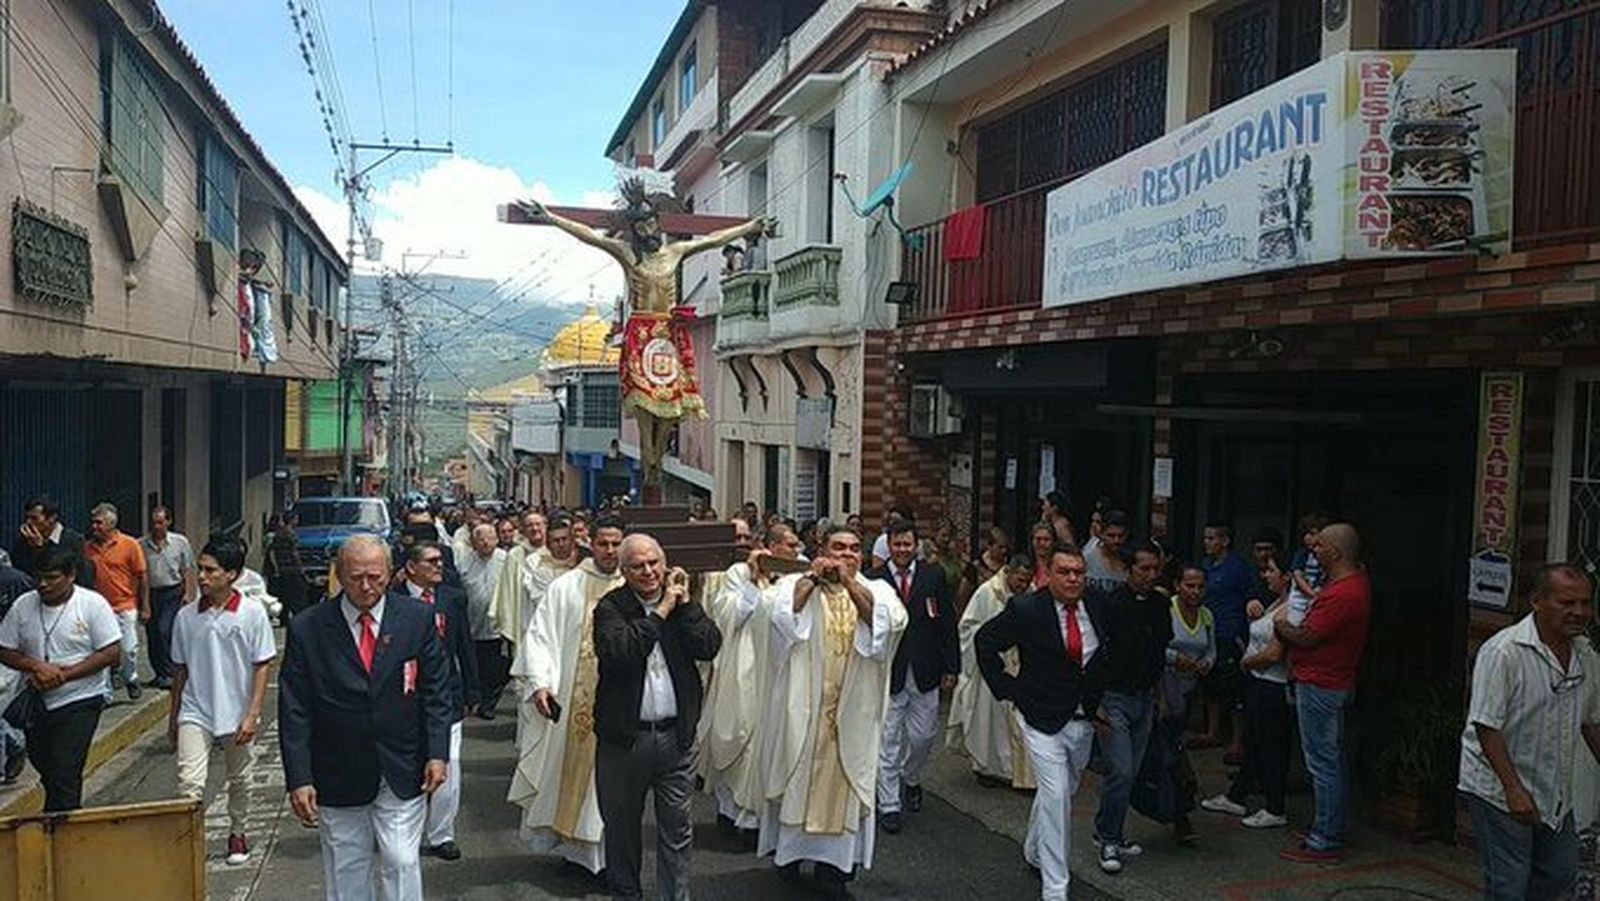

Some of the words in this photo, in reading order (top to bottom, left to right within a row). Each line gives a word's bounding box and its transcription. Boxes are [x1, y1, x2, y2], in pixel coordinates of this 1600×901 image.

[1141, 92, 1327, 208] RESTAURANT
[1359, 61, 1391, 248] RESTAURANT
[1482, 382, 1513, 545] RESTAURANT
